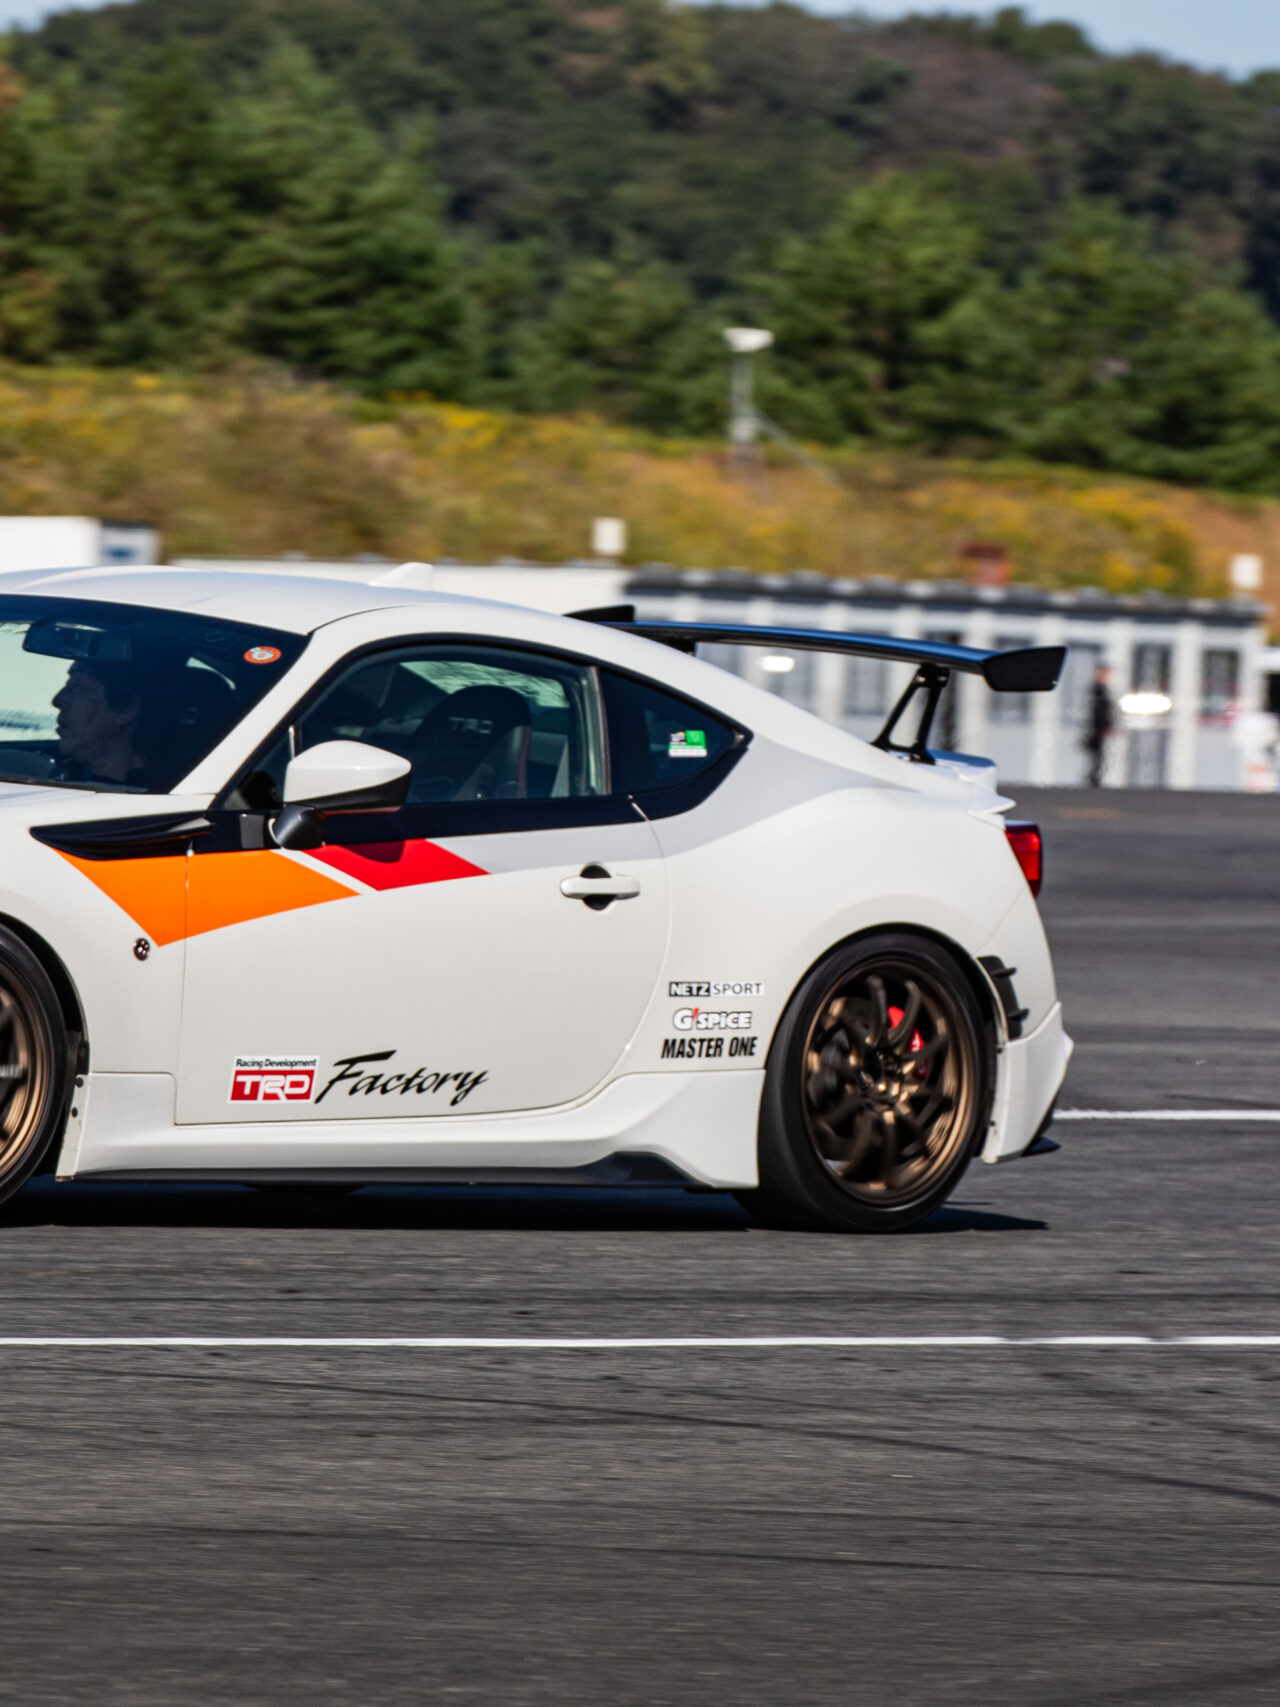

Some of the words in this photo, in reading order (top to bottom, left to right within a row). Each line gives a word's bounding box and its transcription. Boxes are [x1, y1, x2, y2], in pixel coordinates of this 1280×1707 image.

[670, 982, 710, 997] NETZ
[713, 983, 762, 995] SPORT
[661, 1037, 724, 1058] MASTER
[728, 1036, 758, 1057] ONE
[236, 1058, 263, 1069] Racing
[265, 1058, 316, 1068] Development
[235, 1074, 311, 1102] TRD
[314, 1050, 490, 1106] Factory
